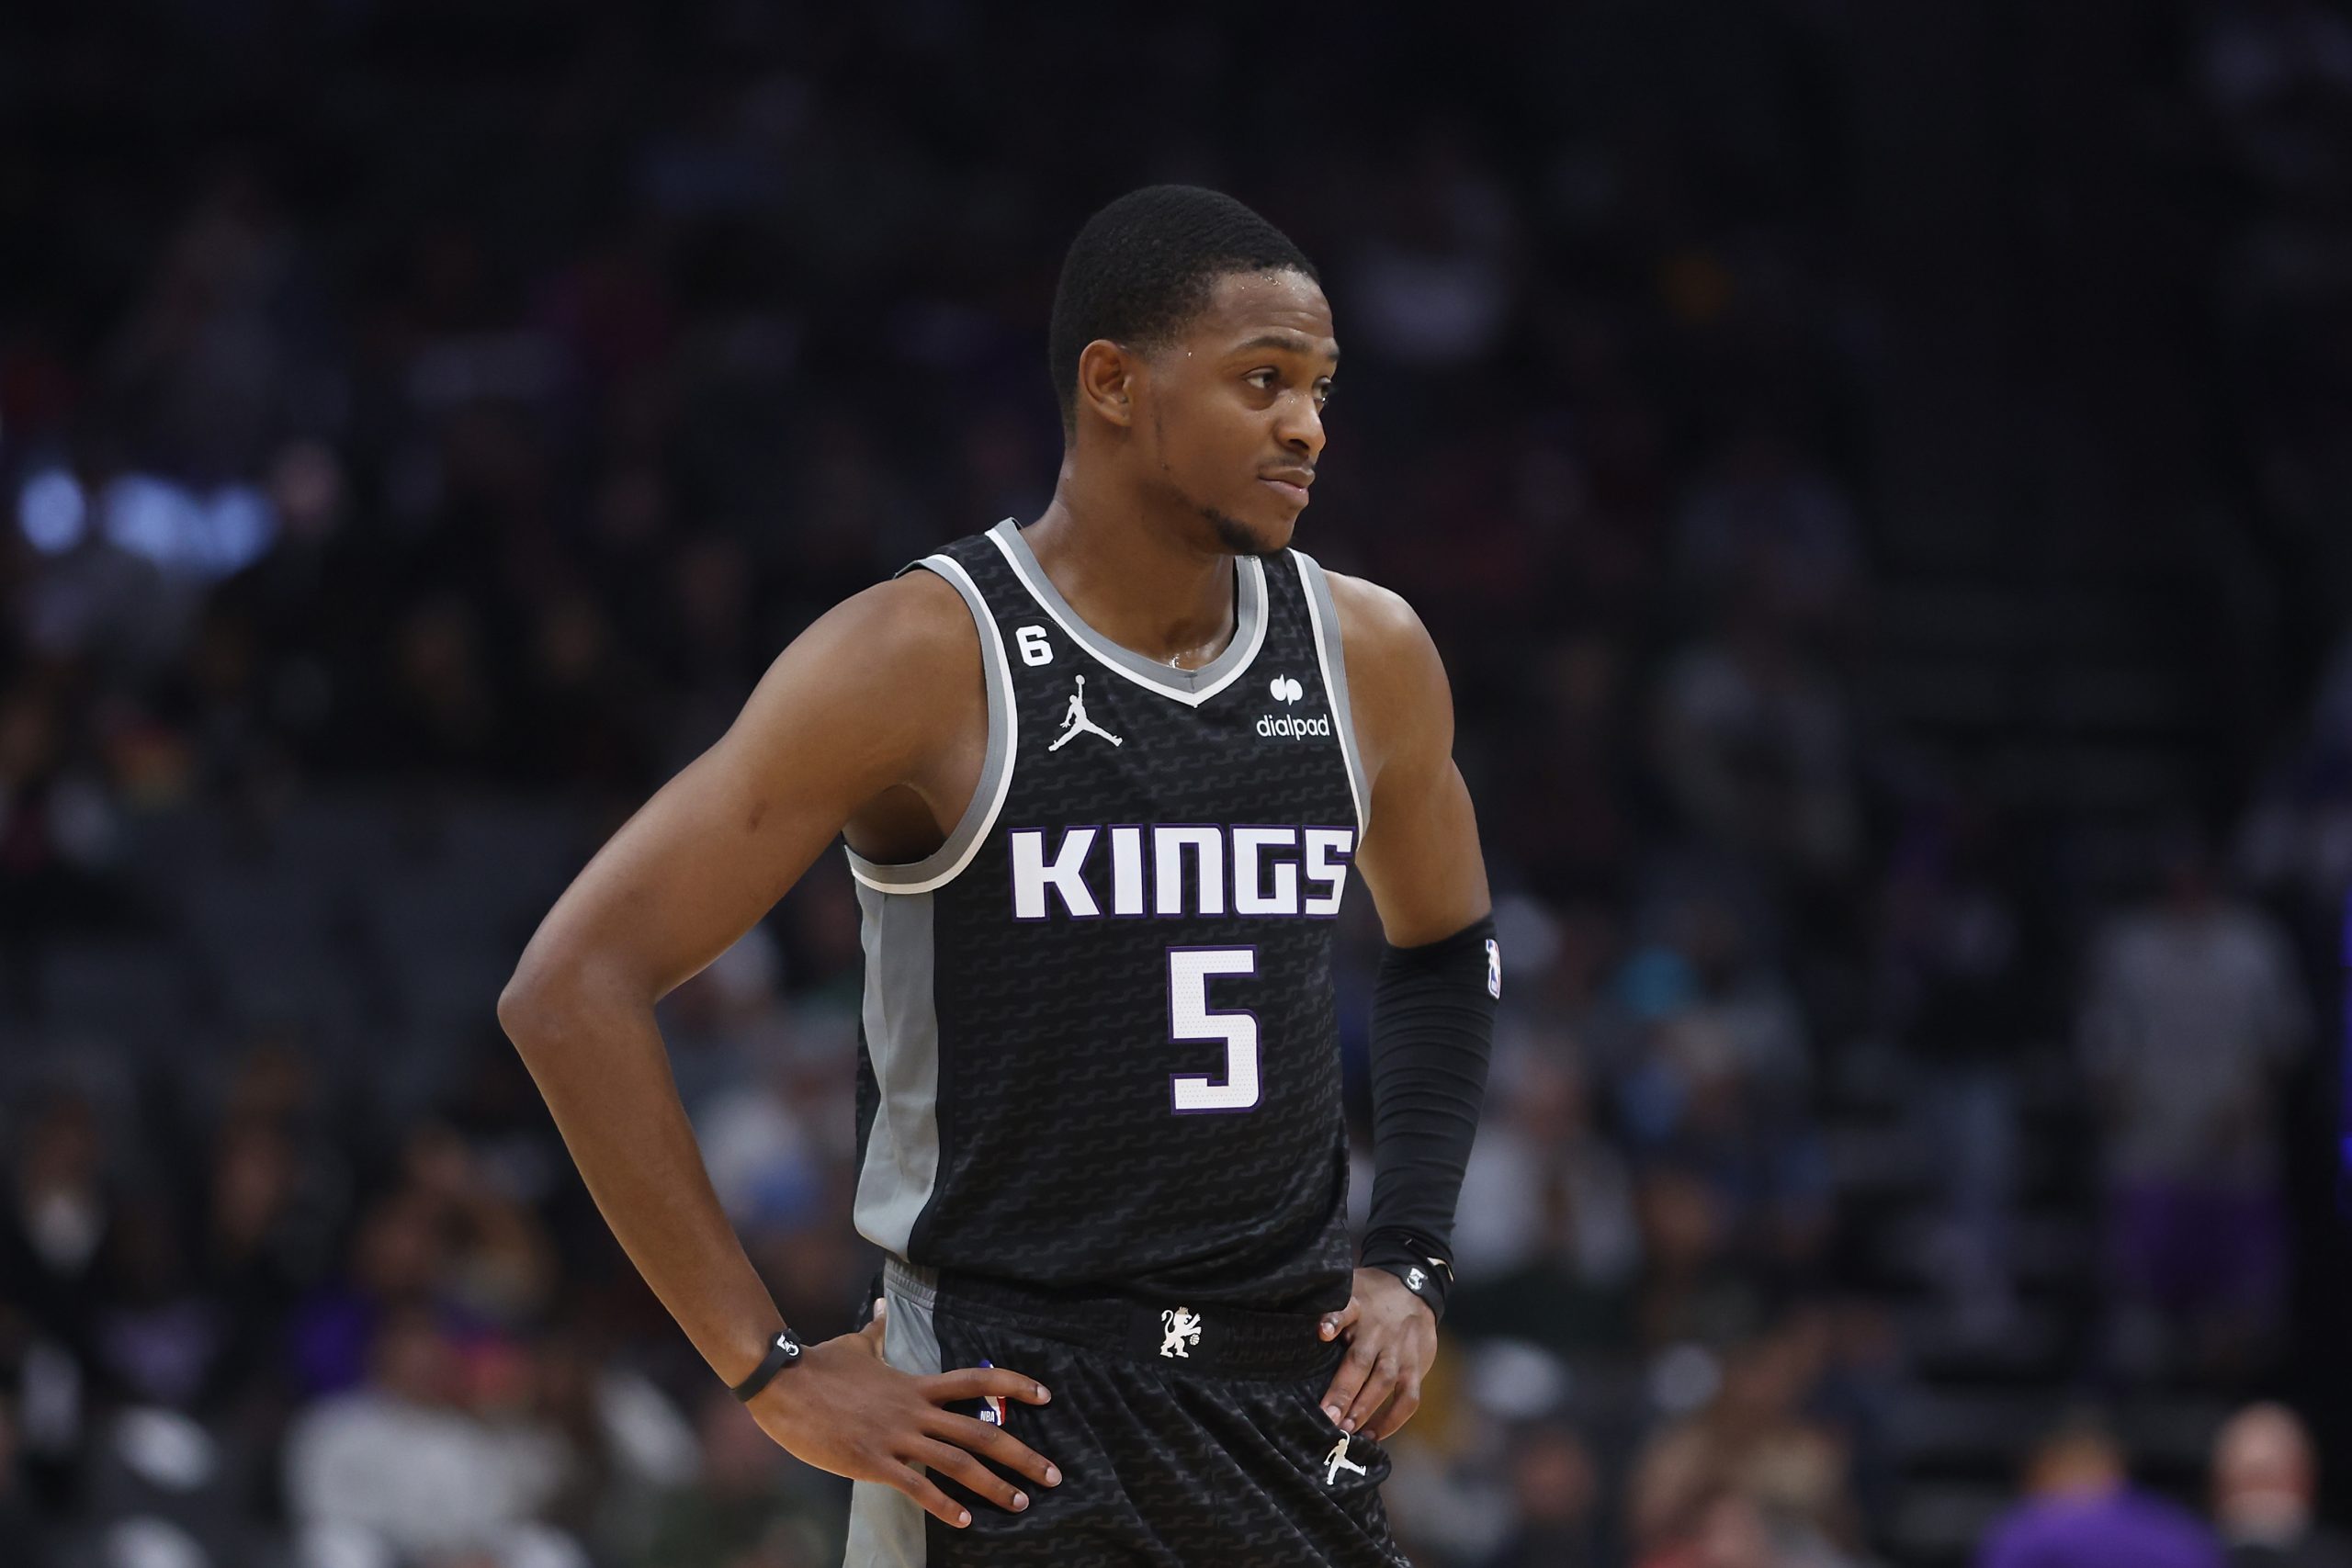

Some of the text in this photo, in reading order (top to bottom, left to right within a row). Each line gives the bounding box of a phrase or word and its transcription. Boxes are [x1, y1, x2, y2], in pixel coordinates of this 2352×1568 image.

[1015, 625, 1054, 667] 6
[1256, 713, 1330, 741] dialpad
[1008, 823, 1356, 922] KINGS
[1166, 944, 1264, 1116] 5
[980, 1410, 995, 1423] NBA
